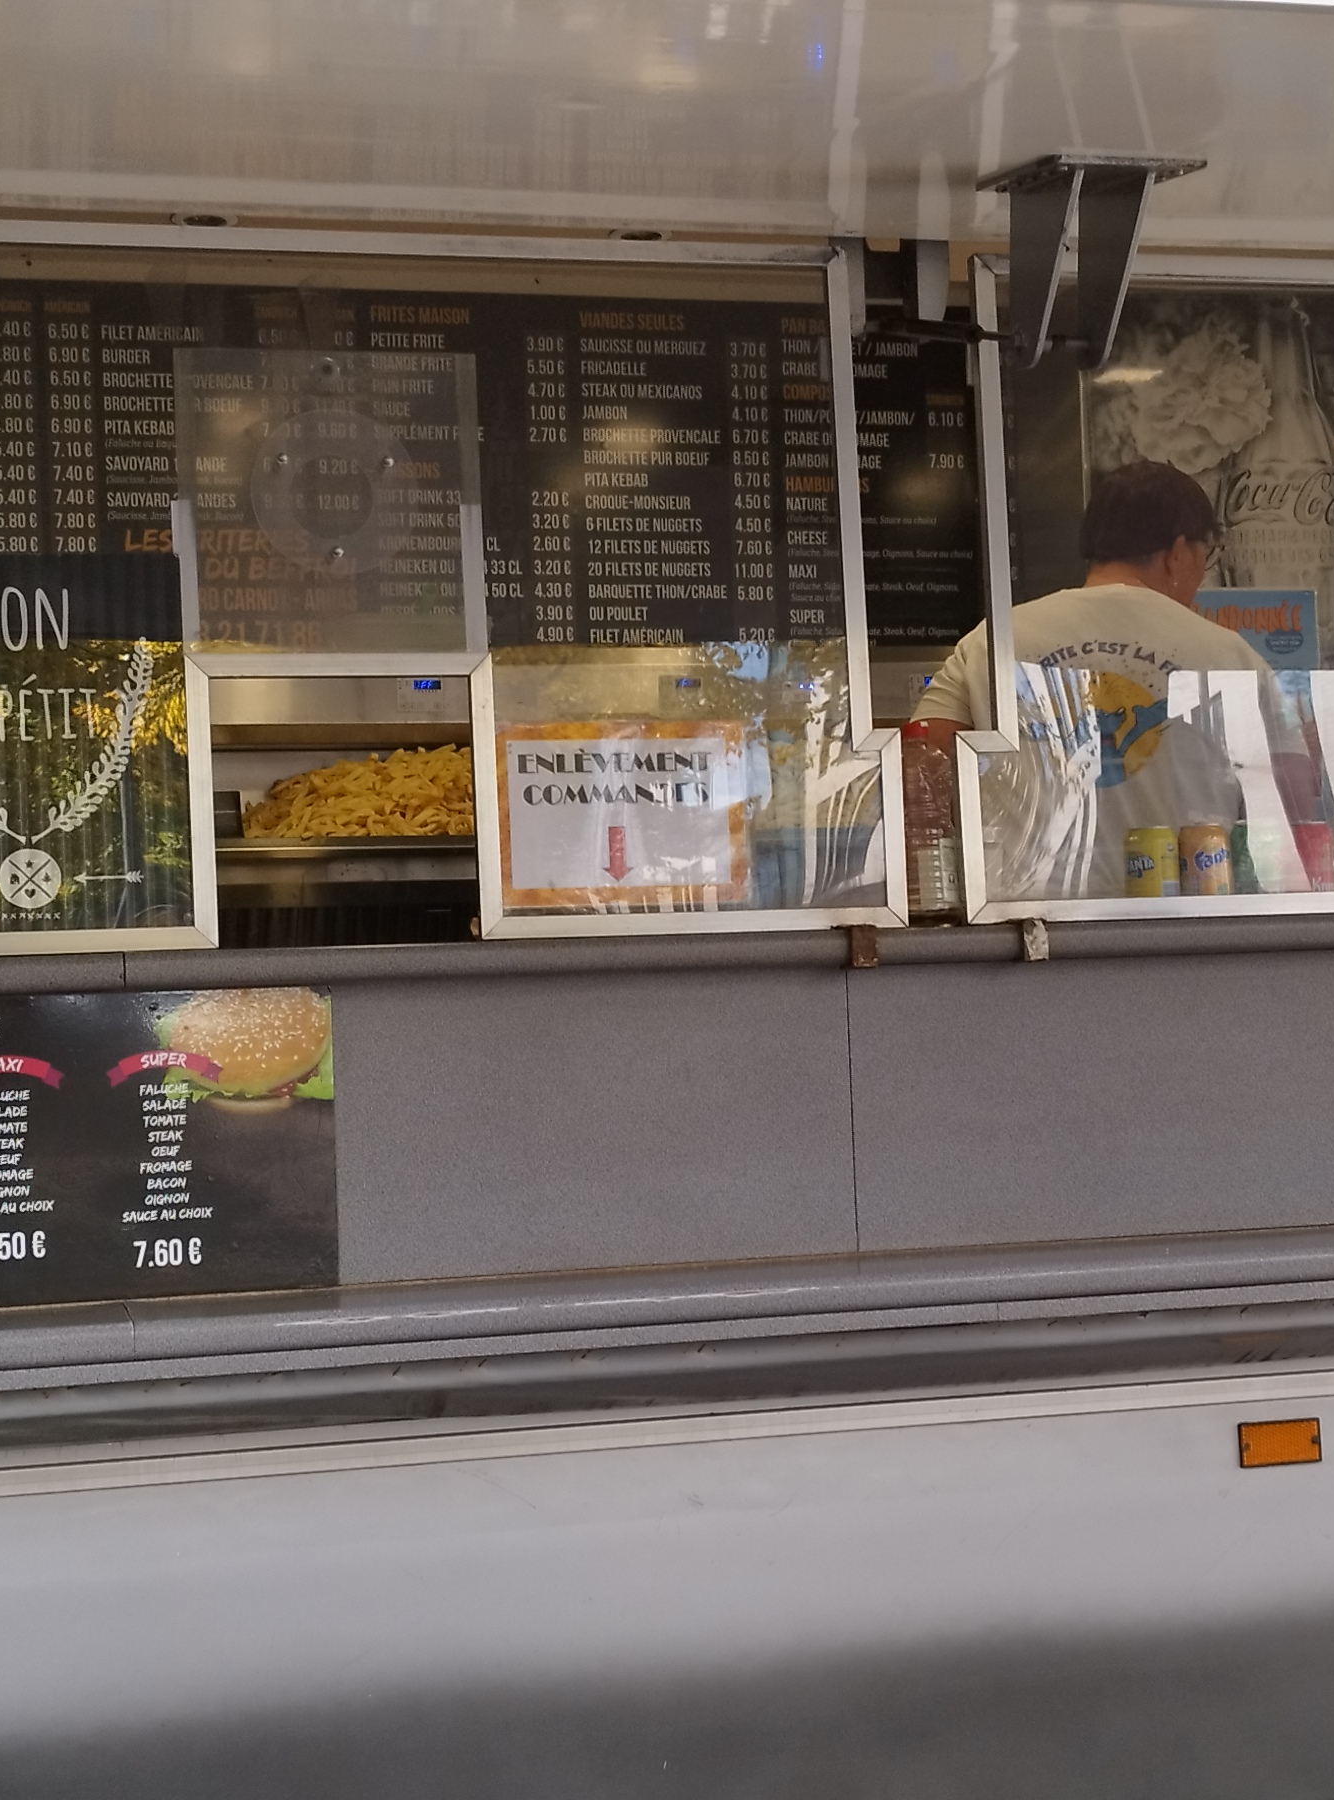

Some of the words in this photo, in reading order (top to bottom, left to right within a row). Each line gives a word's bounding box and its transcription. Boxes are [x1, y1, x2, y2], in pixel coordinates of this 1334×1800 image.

[371, 307, 415, 323] FRITES
[419, 307, 469, 325] MAISON
[580, 312, 634, 330] VIANDES
[637, 313, 684, 330] SEULES
[371, 333, 410, 348] PETITE
[413, 333, 445, 349] FRITE
[580, 339, 633, 353] SAUCISSE
[636, 341, 651, 353] OU
[654, 340, 705, 355] MERGUEZ
[102, 349, 150, 364] BURGER
[581, 361, 646, 376] FRICADELLE
[103, 373, 173, 388] BROCHETTE
[582, 383, 617, 398] STEAK
[620, 385, 635, 398] OU
[638, 384, 702, 400] MEXICANOS
[530, 406, 557, 420] 1.00
[559, 406, 566, 420] €
[583, 406, 627, 420] JAMBON
[929, 412, 954, 426] 6.10
[957, 412, 963, 426] €
[105, 421, 131, 435] PITA
[134, 420, 174, 436] KEBAB
[53, 442, 81, 457] 7.10
[85, 442, 92, 457] €
[106, 456, 169, 471] SAVOYARD
[586, 495, 691, 511] CROQUE-MONSIEUR
[786, 498, 827, 512] NATURE
[30, 537, 38, 552] €
[56, 537, 85, 552] 7.80
[88, 537, 96, 552] €
[126, 529, 172, 552] LES
[787, 531, 828, 545] CHEESE
[588, 562, 602, 576] 20
[605, 562, 642, 576] FILETS
[644, 562, 658, 576] DE
[661, 562, 711, 577] NUGGETS
[735, 564, 764, 578] 11.00
[766, 564, 772, 578] €
[789, 564, 817, 578] MAXI
[790, 610, 824, 624] SUPER
[1039, 645, 1077, 671] RITE
[1081, 639, 1129, 656] C'EST
[1134, 646, 1156, 664] LA
[517, 748, 712, 774] ENLÈVEMENT
[141, 1051, 187, 1069] SUPER
[139, 1082, 189, 1096] FALUCHE
[143, 1098, 187, 1111] SALADE
[143, 1114, 187, 1126] TOMATE
[146, 1129, 183, 1142] STEAK
[139, 1160, 192, 1173] FROMAGE
[146, 1177, 186, 1189] BACON
[145, 1192, 189, 1204] OIGNON
[4, 1201, 18, 1214] AU
[21, 1200, 54, 1212] CHOIX
[122, 1209, 161, 1222] SAUCE
[164, 1208, 178, 1221] AU
[181, 1206, 213, 1219] CHOIX
[31, 1231, 46, 1259] €
[133, 1239, 183, 1268] 7.60
[188, 1238, 202, 1265] €
